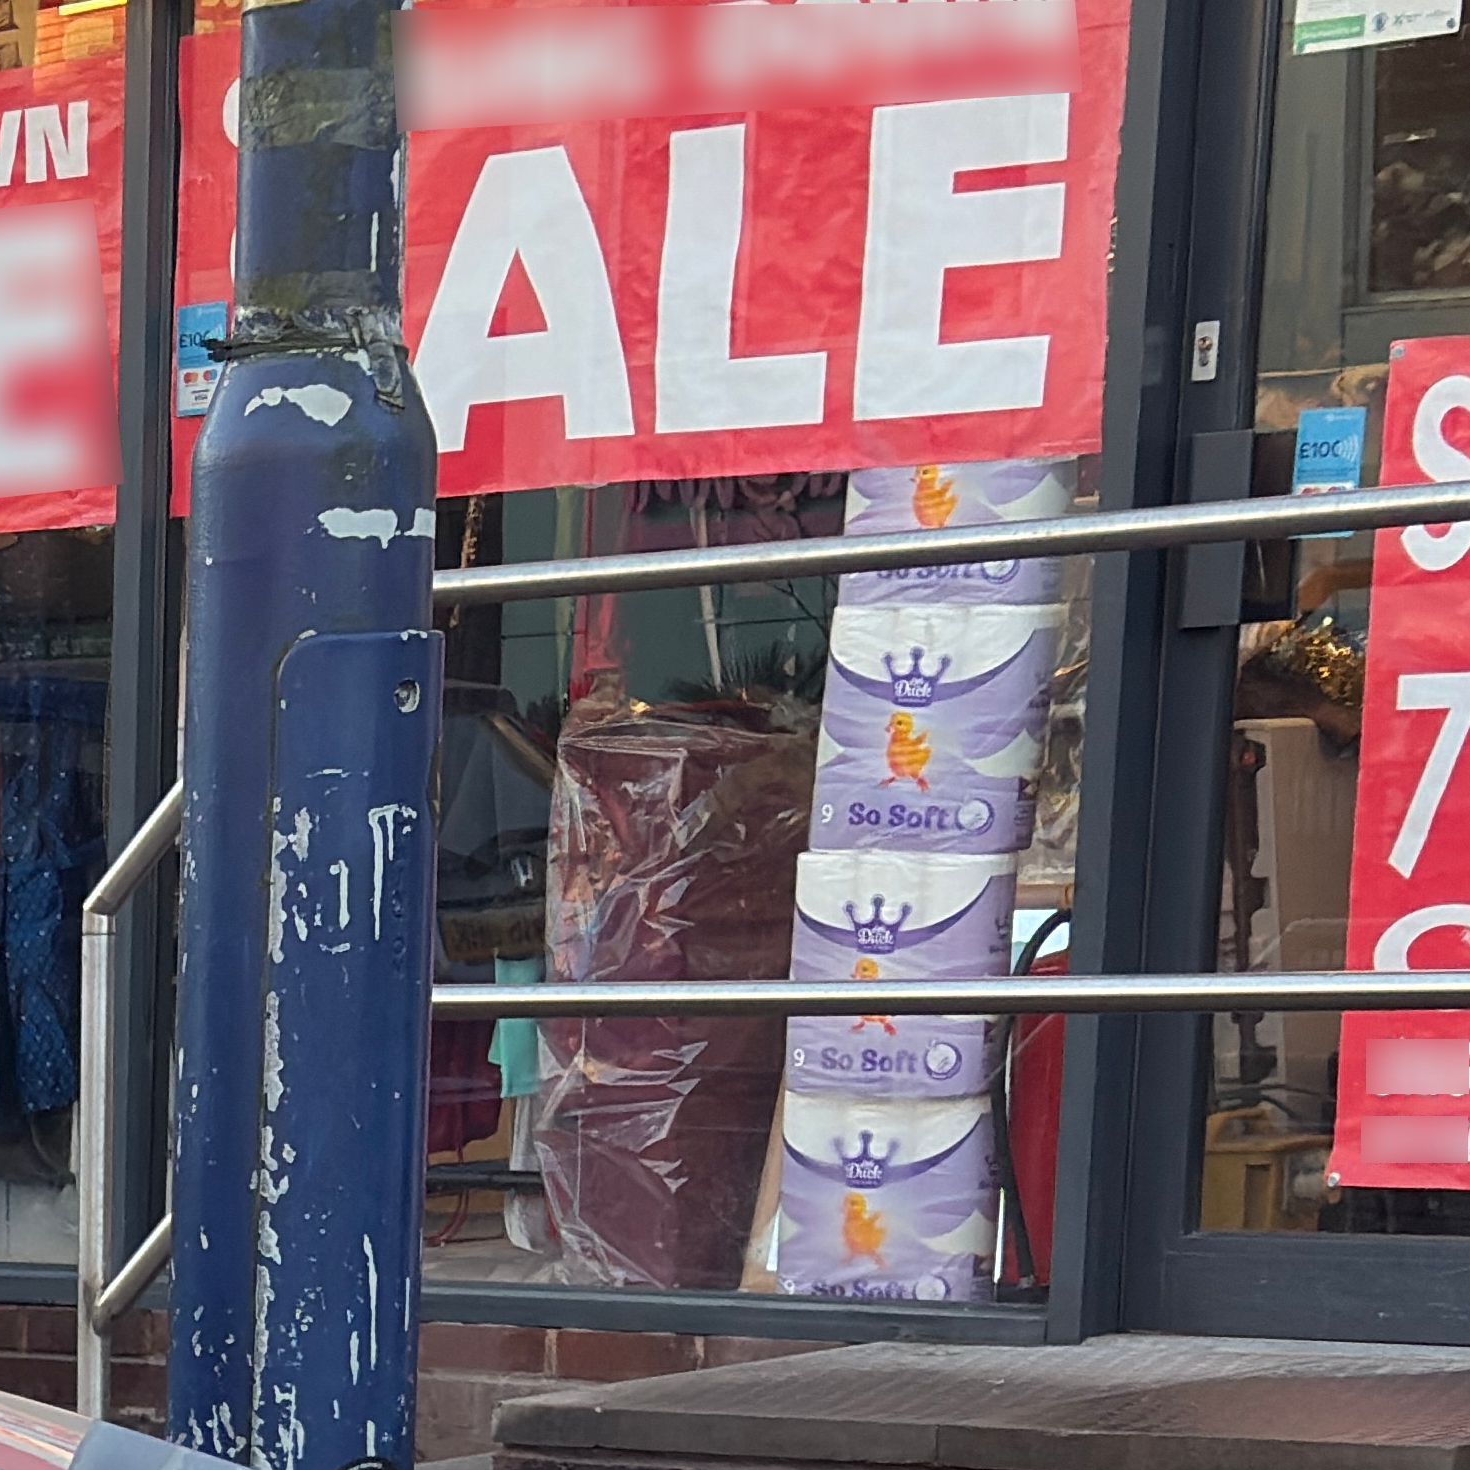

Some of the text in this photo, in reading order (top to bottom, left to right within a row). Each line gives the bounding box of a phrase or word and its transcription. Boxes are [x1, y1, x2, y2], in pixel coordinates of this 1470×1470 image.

[231, 93, 1070, 452] ALE
[894, 679, 932, 699] Duck
[821, 802, 949, 829] 9 So Soft
[858, 928, 894, 946] Duck
[793, 1047, 917, 1073] 9 So Soft
[845, 1163, 882, 1180] Duck
